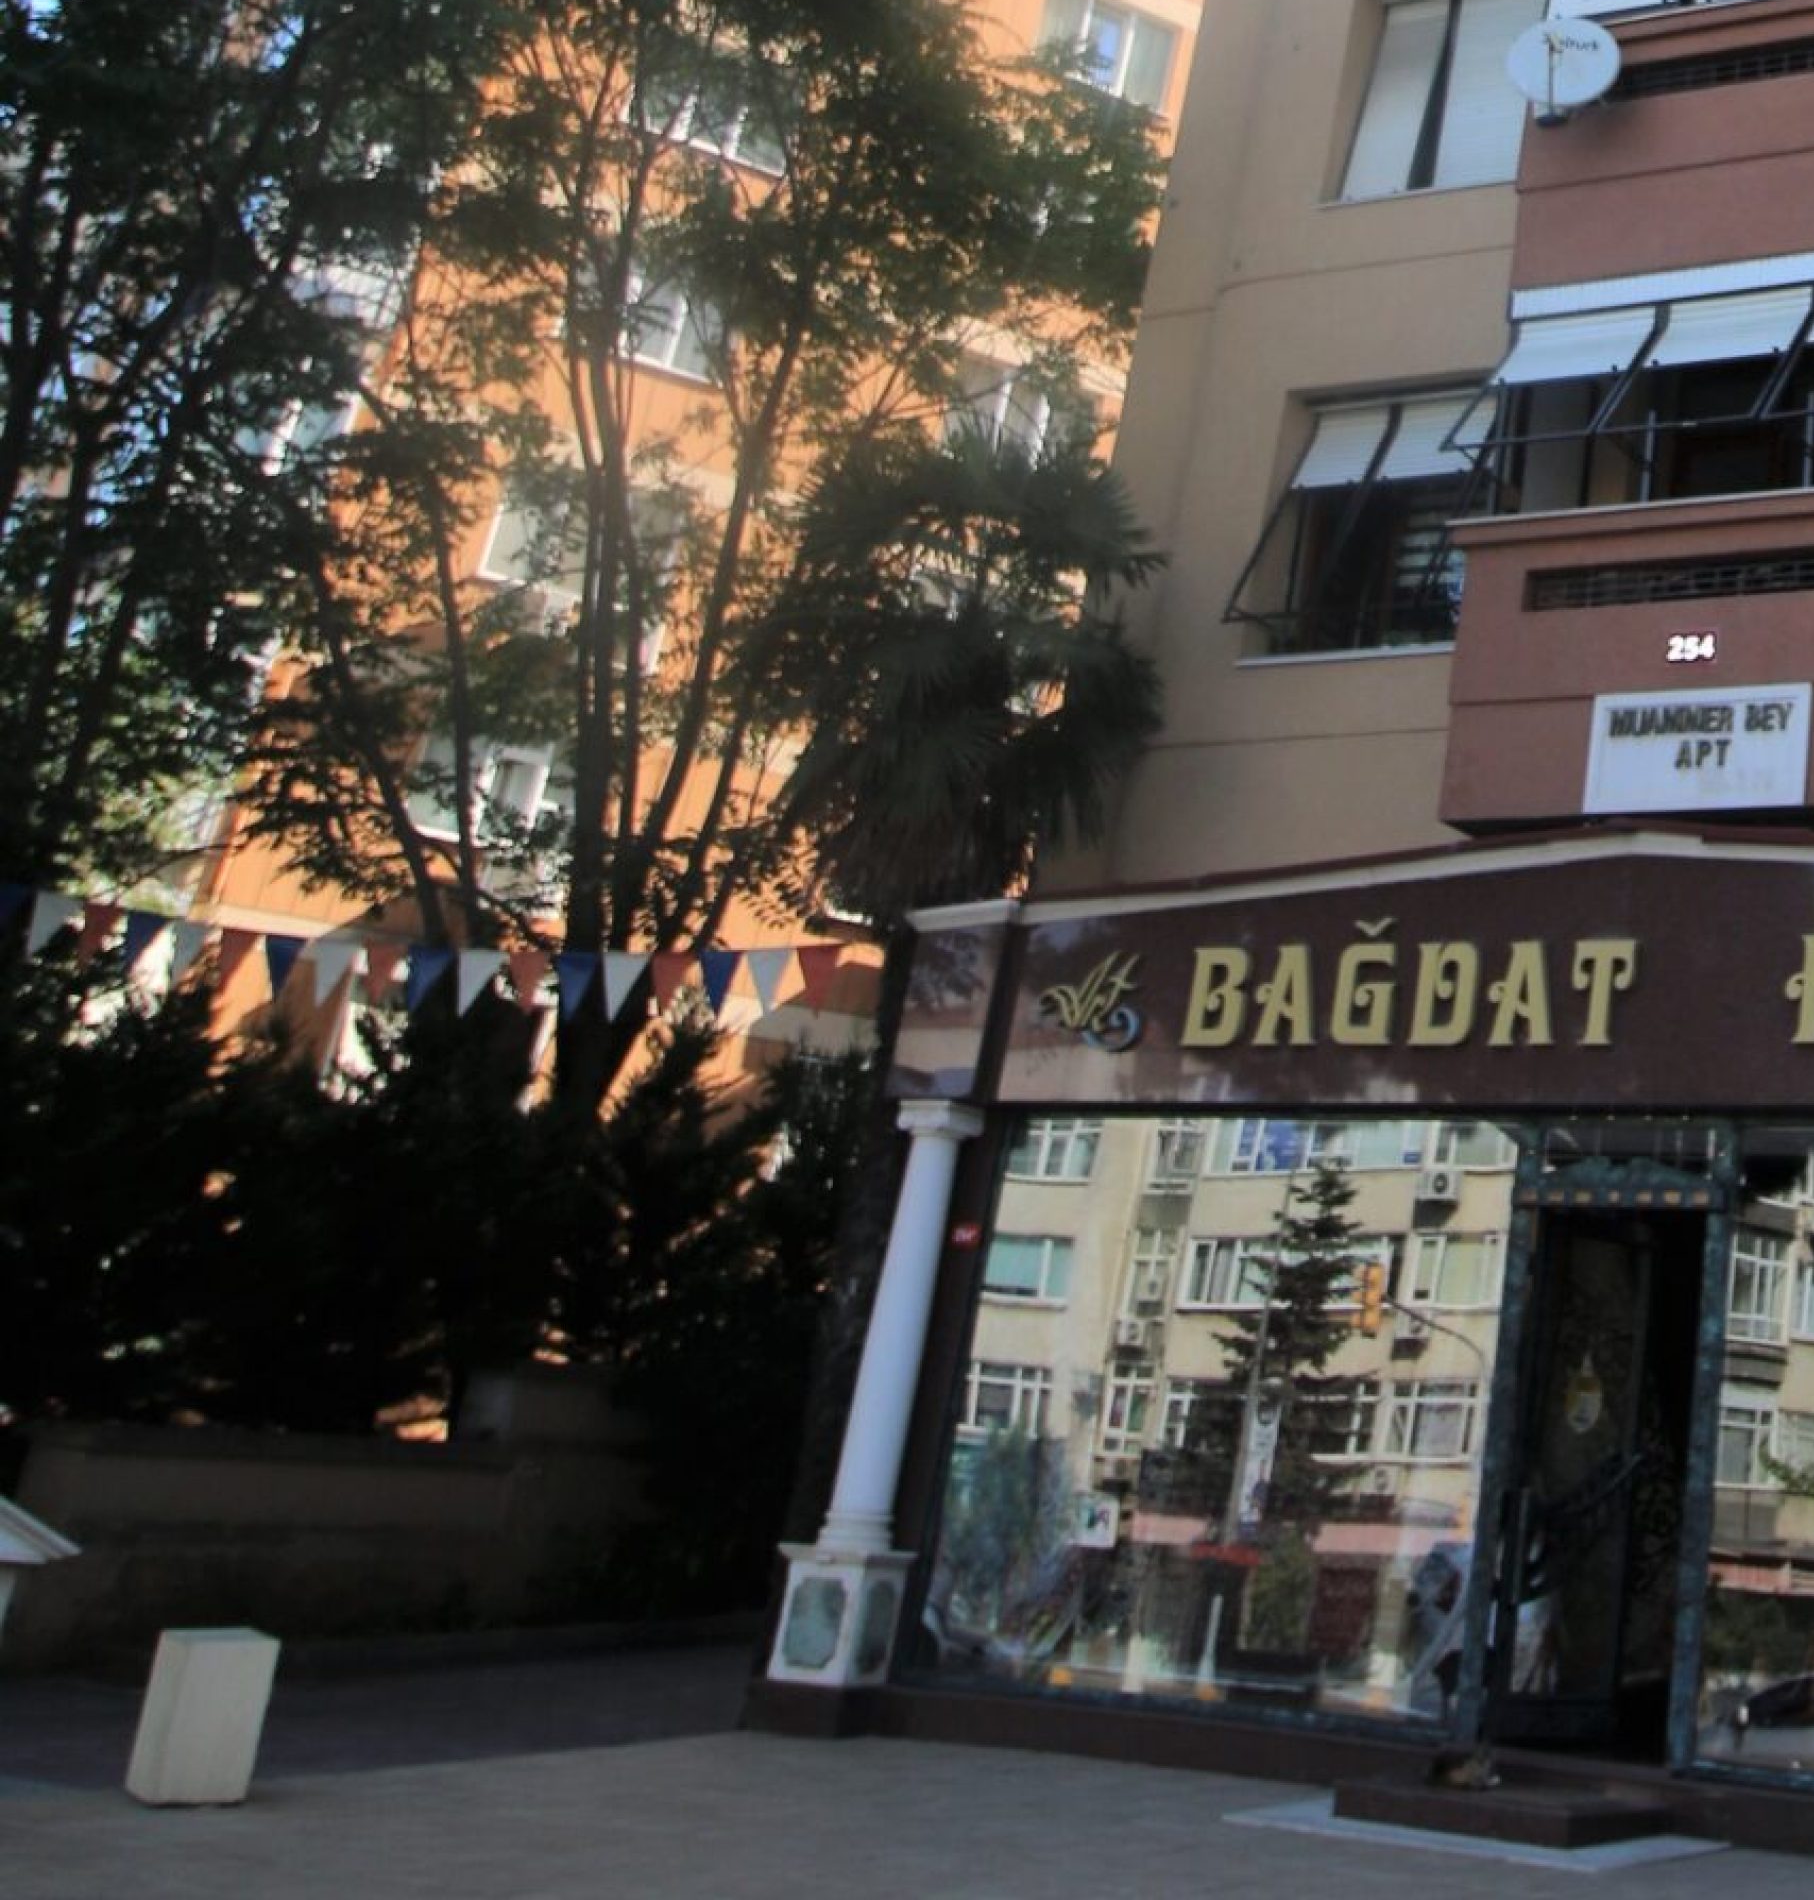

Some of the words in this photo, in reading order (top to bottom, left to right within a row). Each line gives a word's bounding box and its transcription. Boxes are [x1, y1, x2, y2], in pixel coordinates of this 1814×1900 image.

[1666, 633, 1716, 662] 254
[1744, 702, 1794, 732] BEY
[1674, 738, 1732, 769] APT
[1181, 917, 1637, 1047] BAĞDAT
